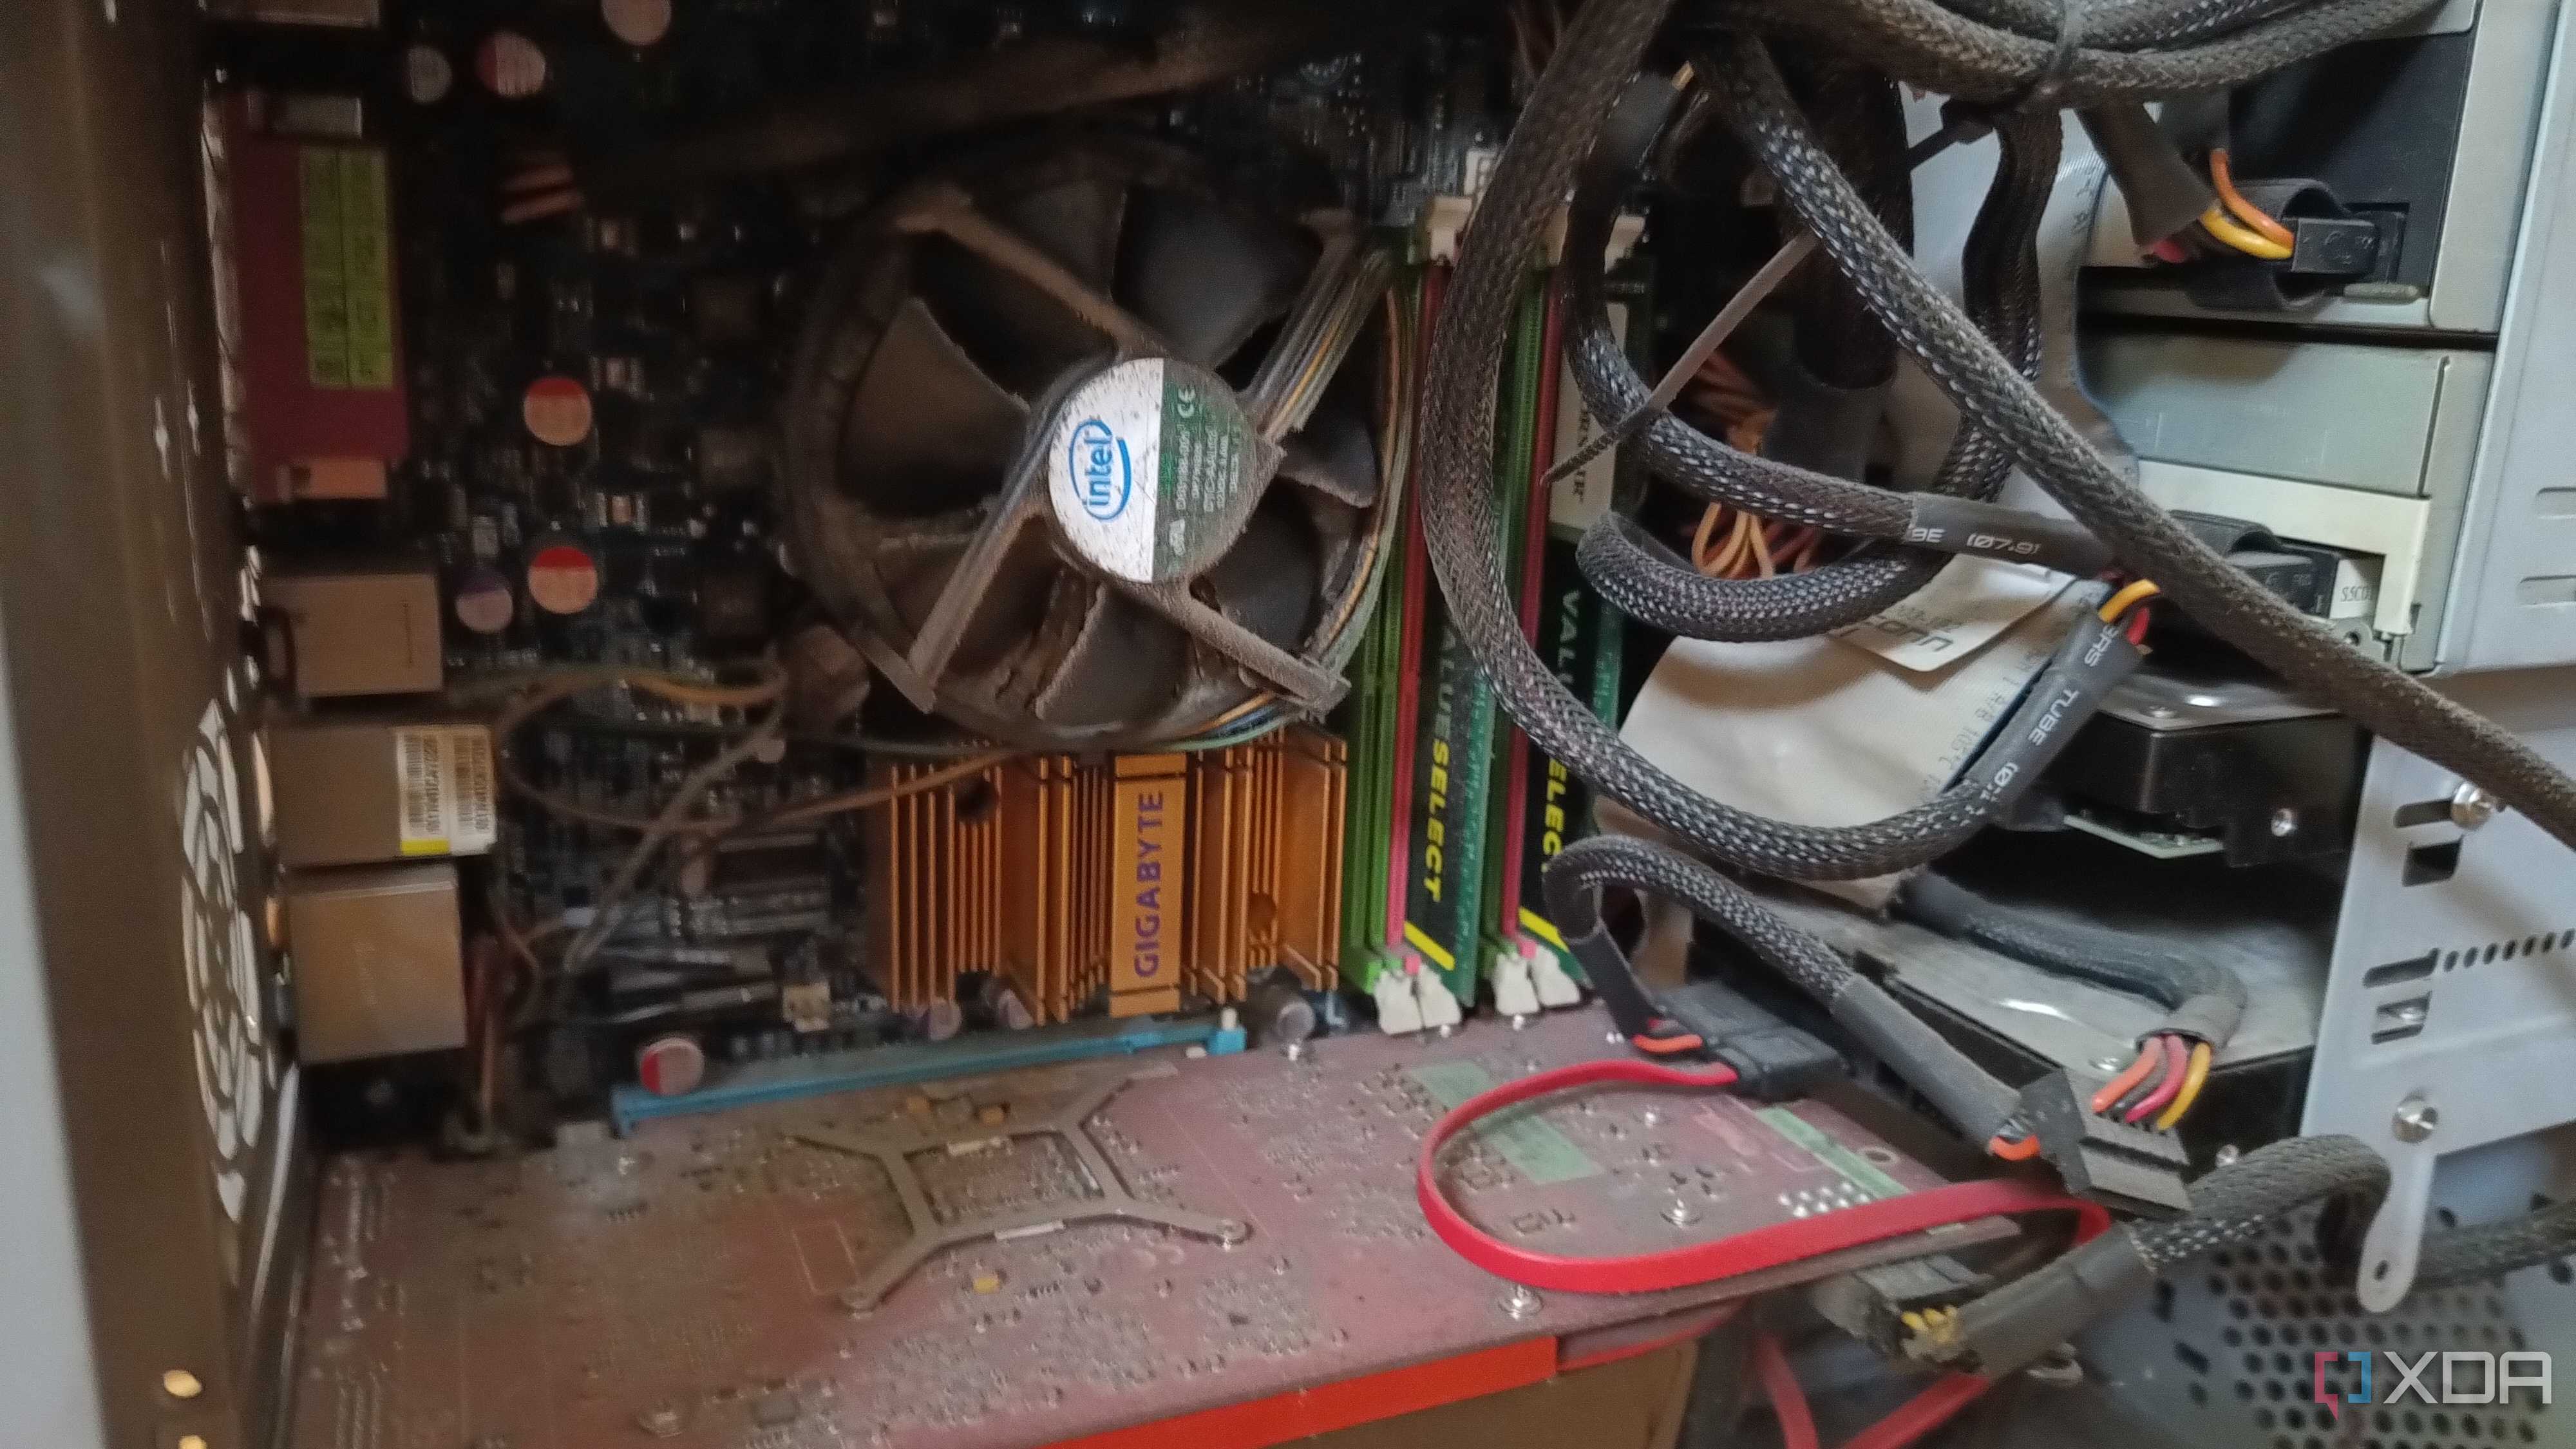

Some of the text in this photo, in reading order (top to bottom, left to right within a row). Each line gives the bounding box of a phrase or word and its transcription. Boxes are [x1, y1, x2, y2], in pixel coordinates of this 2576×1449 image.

[1082, 437, 1113, 506] intel
[2029, 689, 2080, 746] TUBE
[1134, 792, 1164, 978] GIGABYTE
